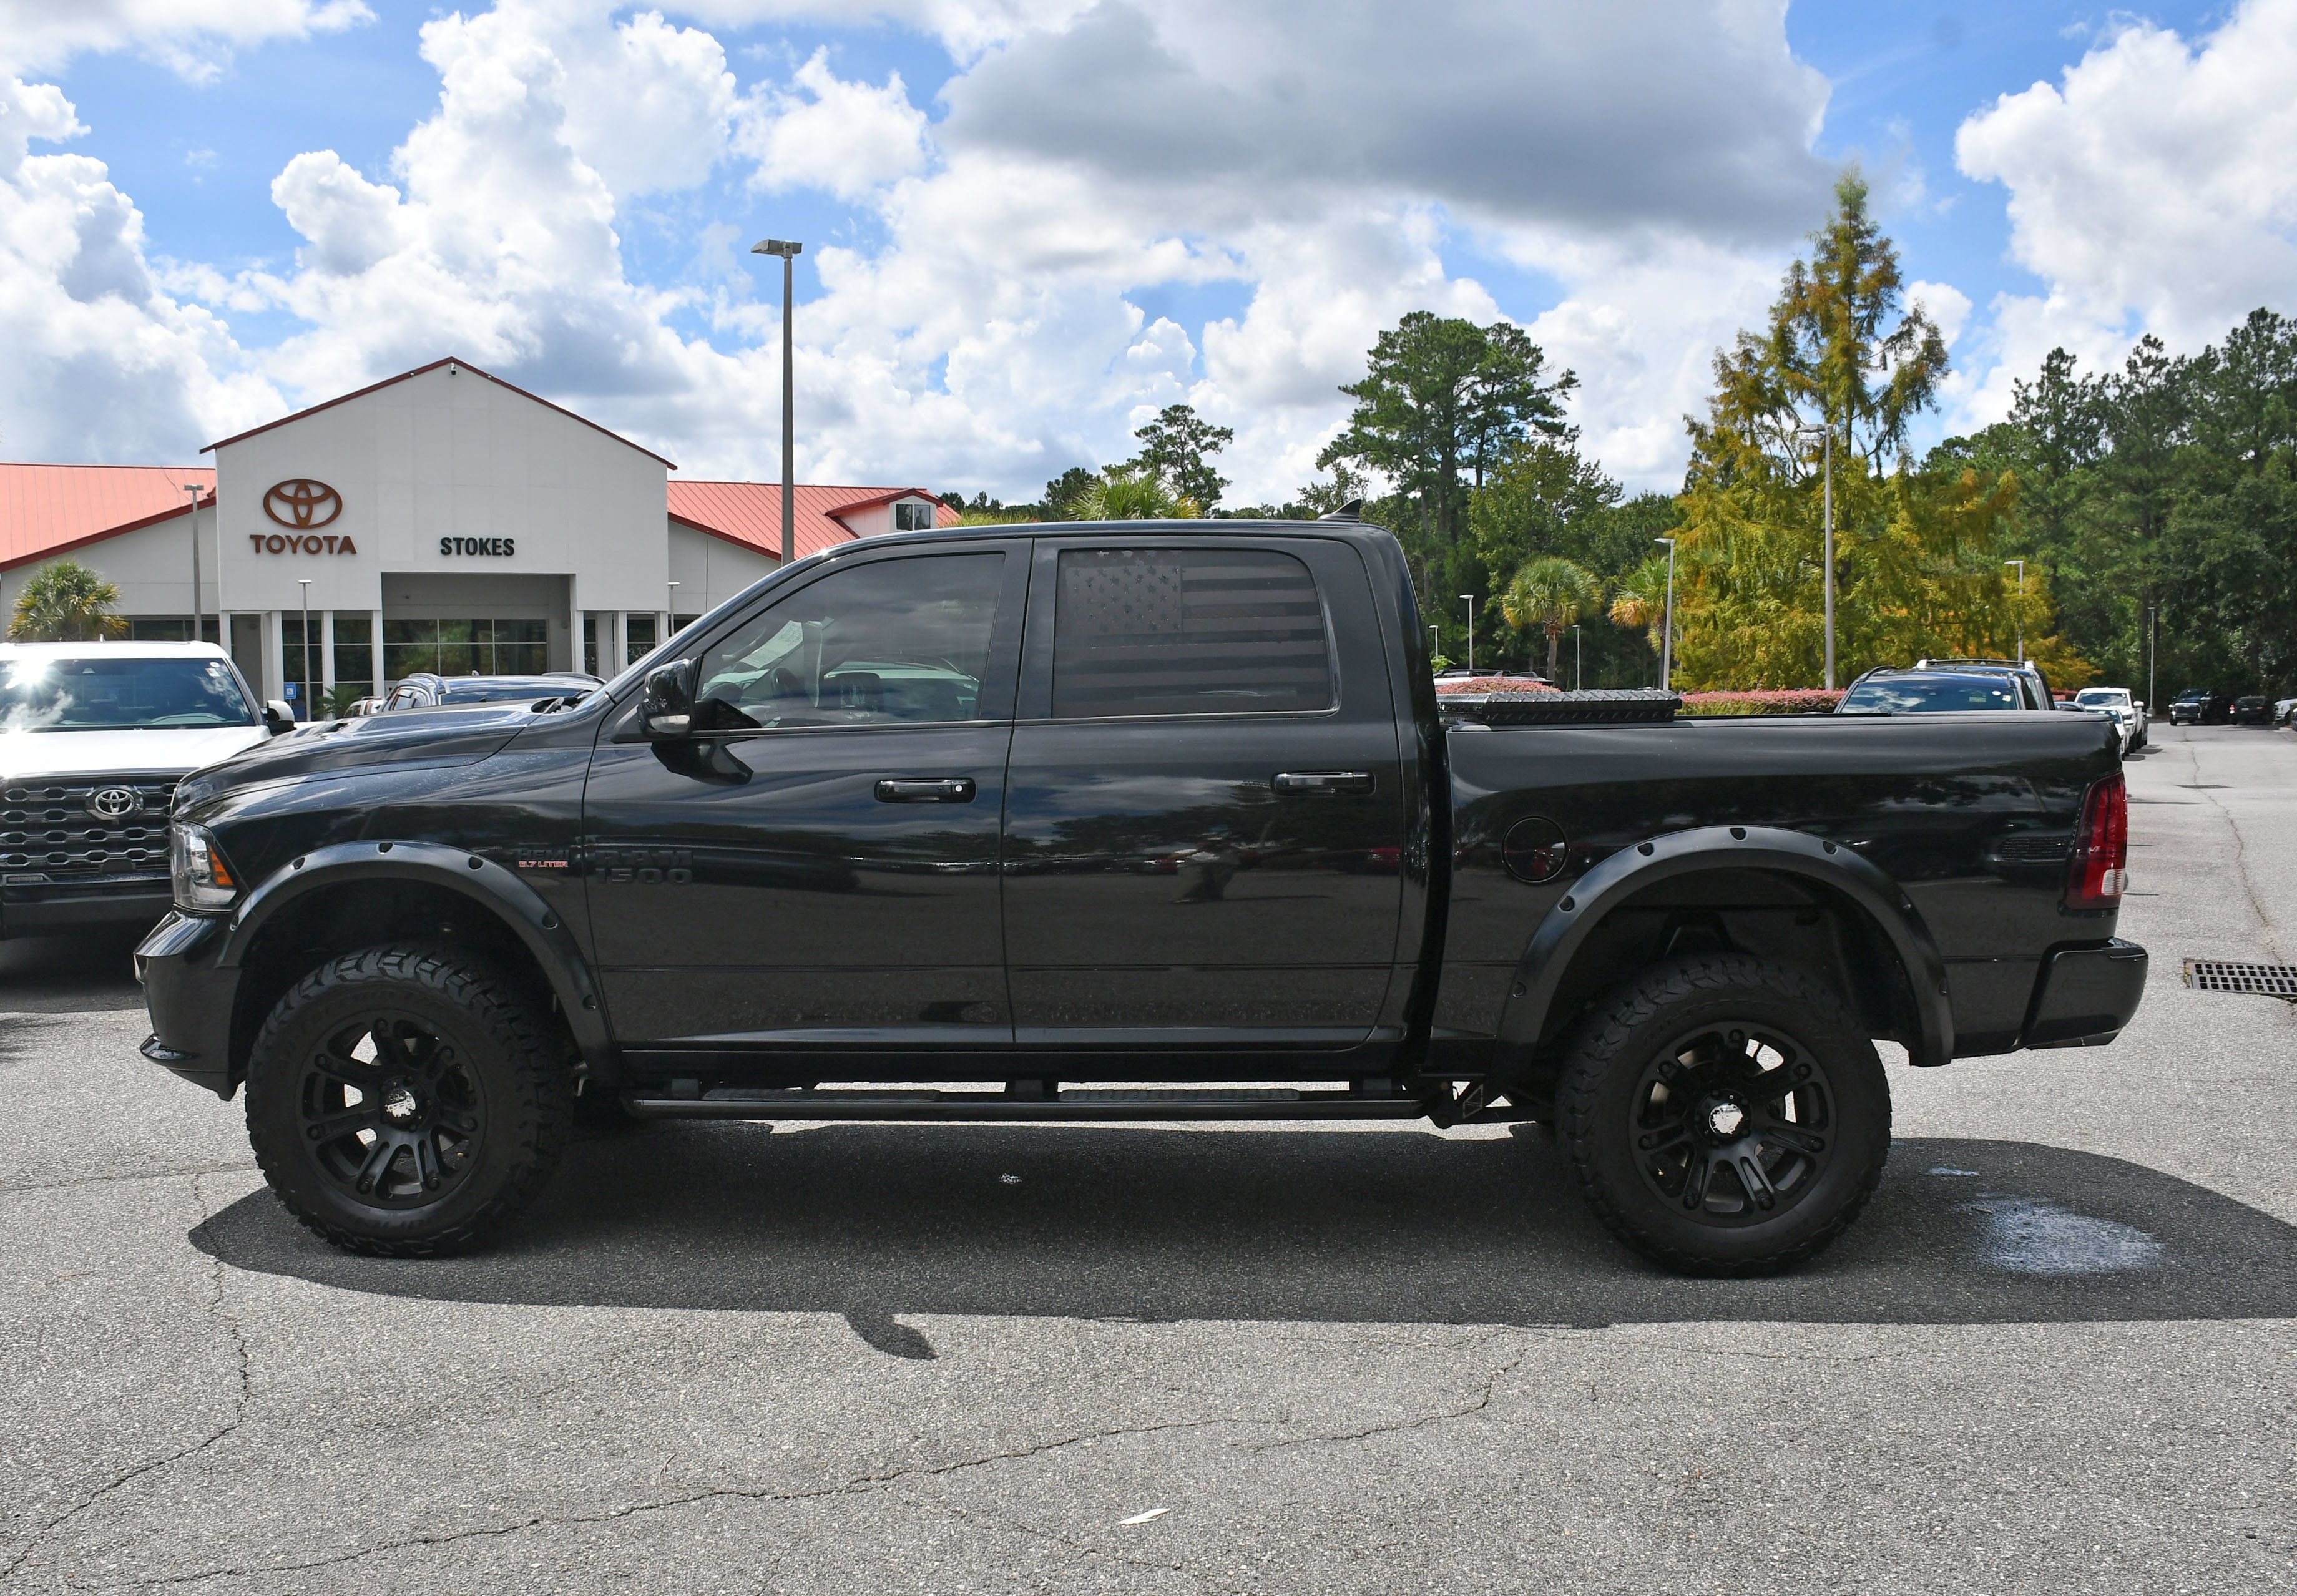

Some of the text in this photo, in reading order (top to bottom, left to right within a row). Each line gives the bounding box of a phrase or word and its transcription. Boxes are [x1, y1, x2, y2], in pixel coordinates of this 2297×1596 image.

[250, 534, 357, 554] TOYOTA
[440, 537, 515, 556] STOKES
[595, 850, 693, 866] RAM
[595, 868, 693, 884] 1500
